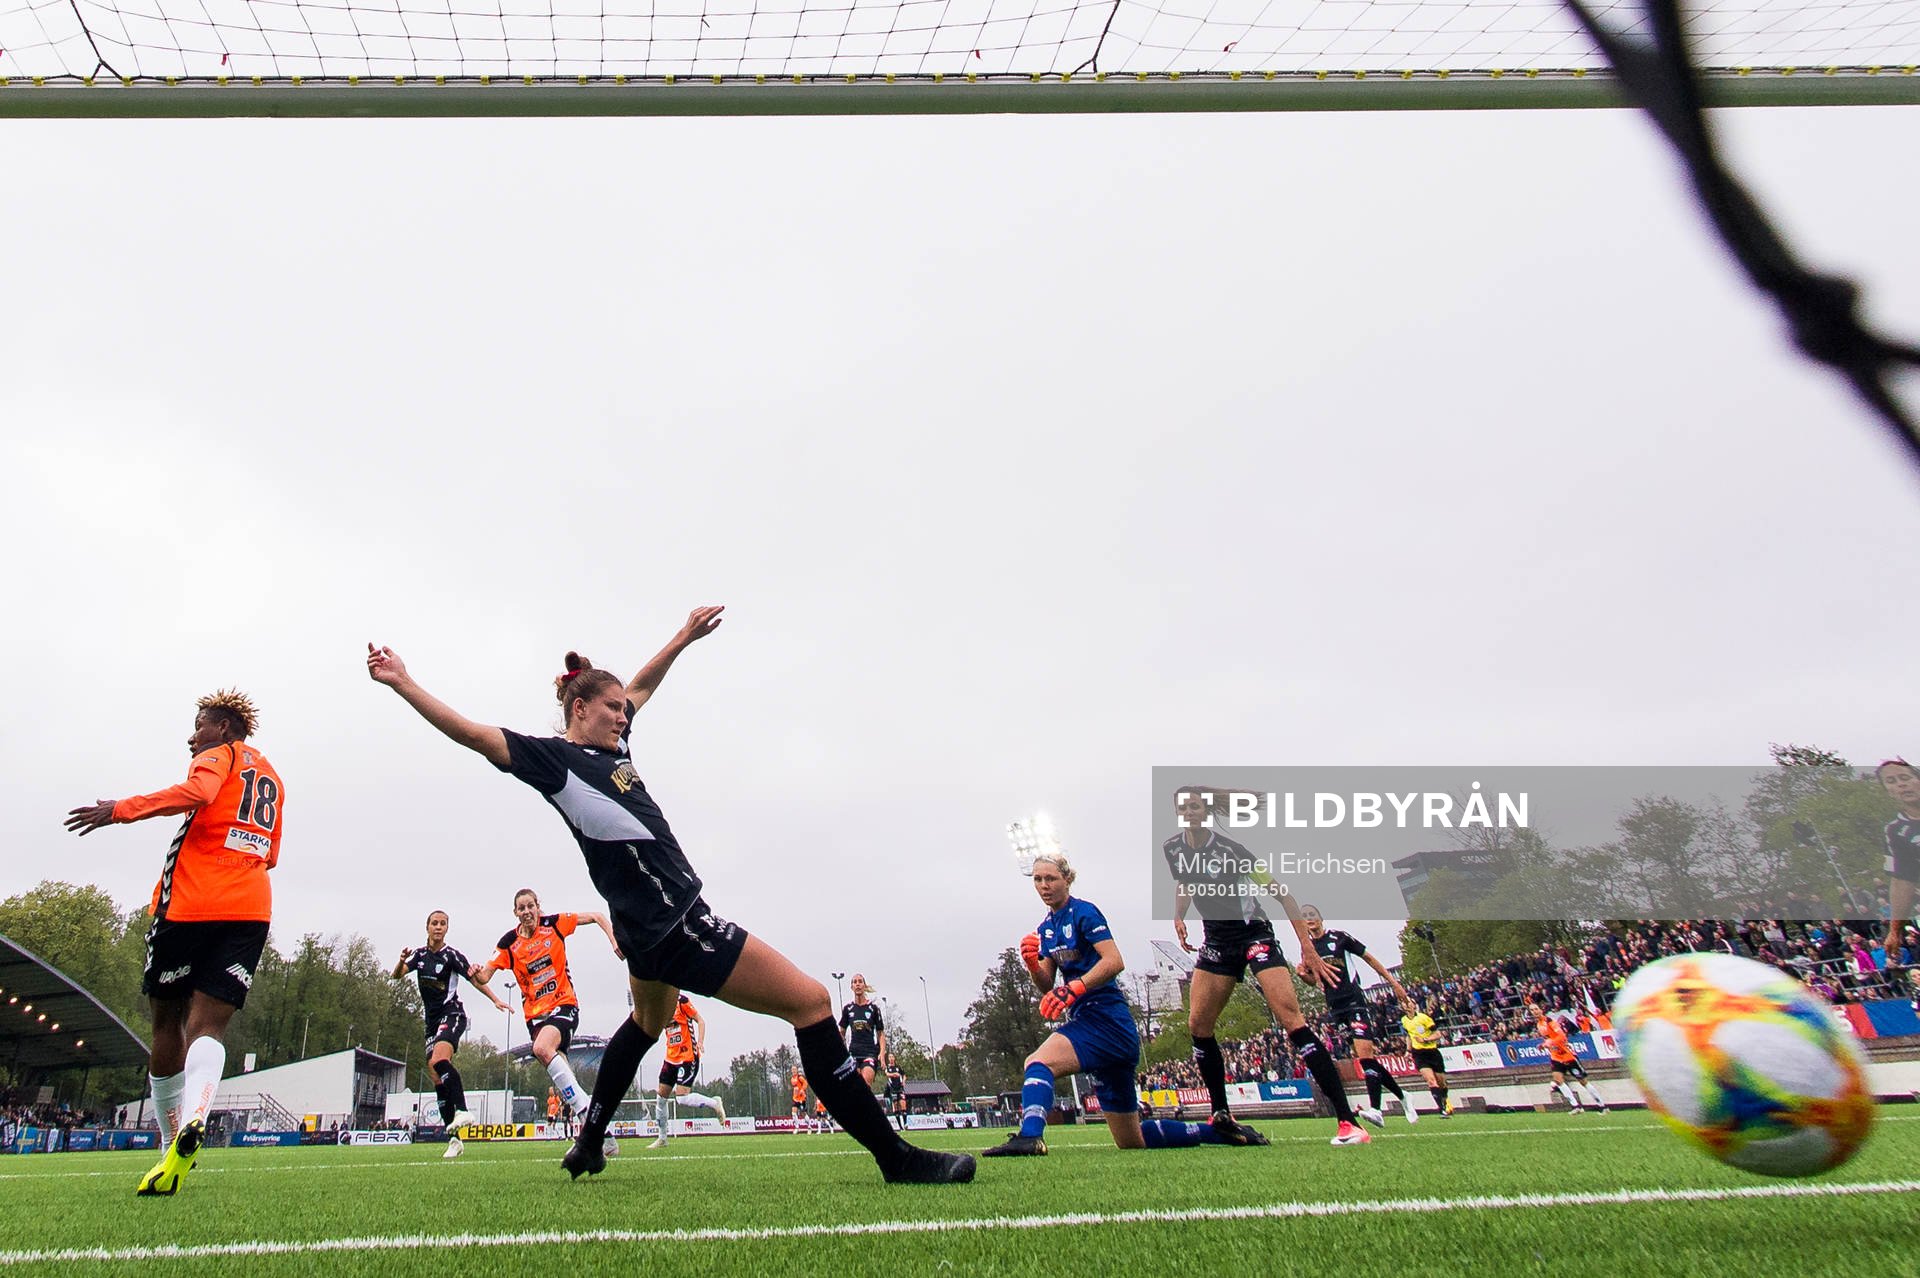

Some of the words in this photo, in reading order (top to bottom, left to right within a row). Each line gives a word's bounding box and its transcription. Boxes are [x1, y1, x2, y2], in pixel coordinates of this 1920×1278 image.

[237, 767, 278, 832] 18
[230, 828, 270, 849] STARKA
[1378, 1055, 1416, 1073] HAUS
[467, 1124, 513, 1138] EHRAB
[755, 1119, 774, 1127] OLKA
[355, 1132, 412, 1143] FIBRA
